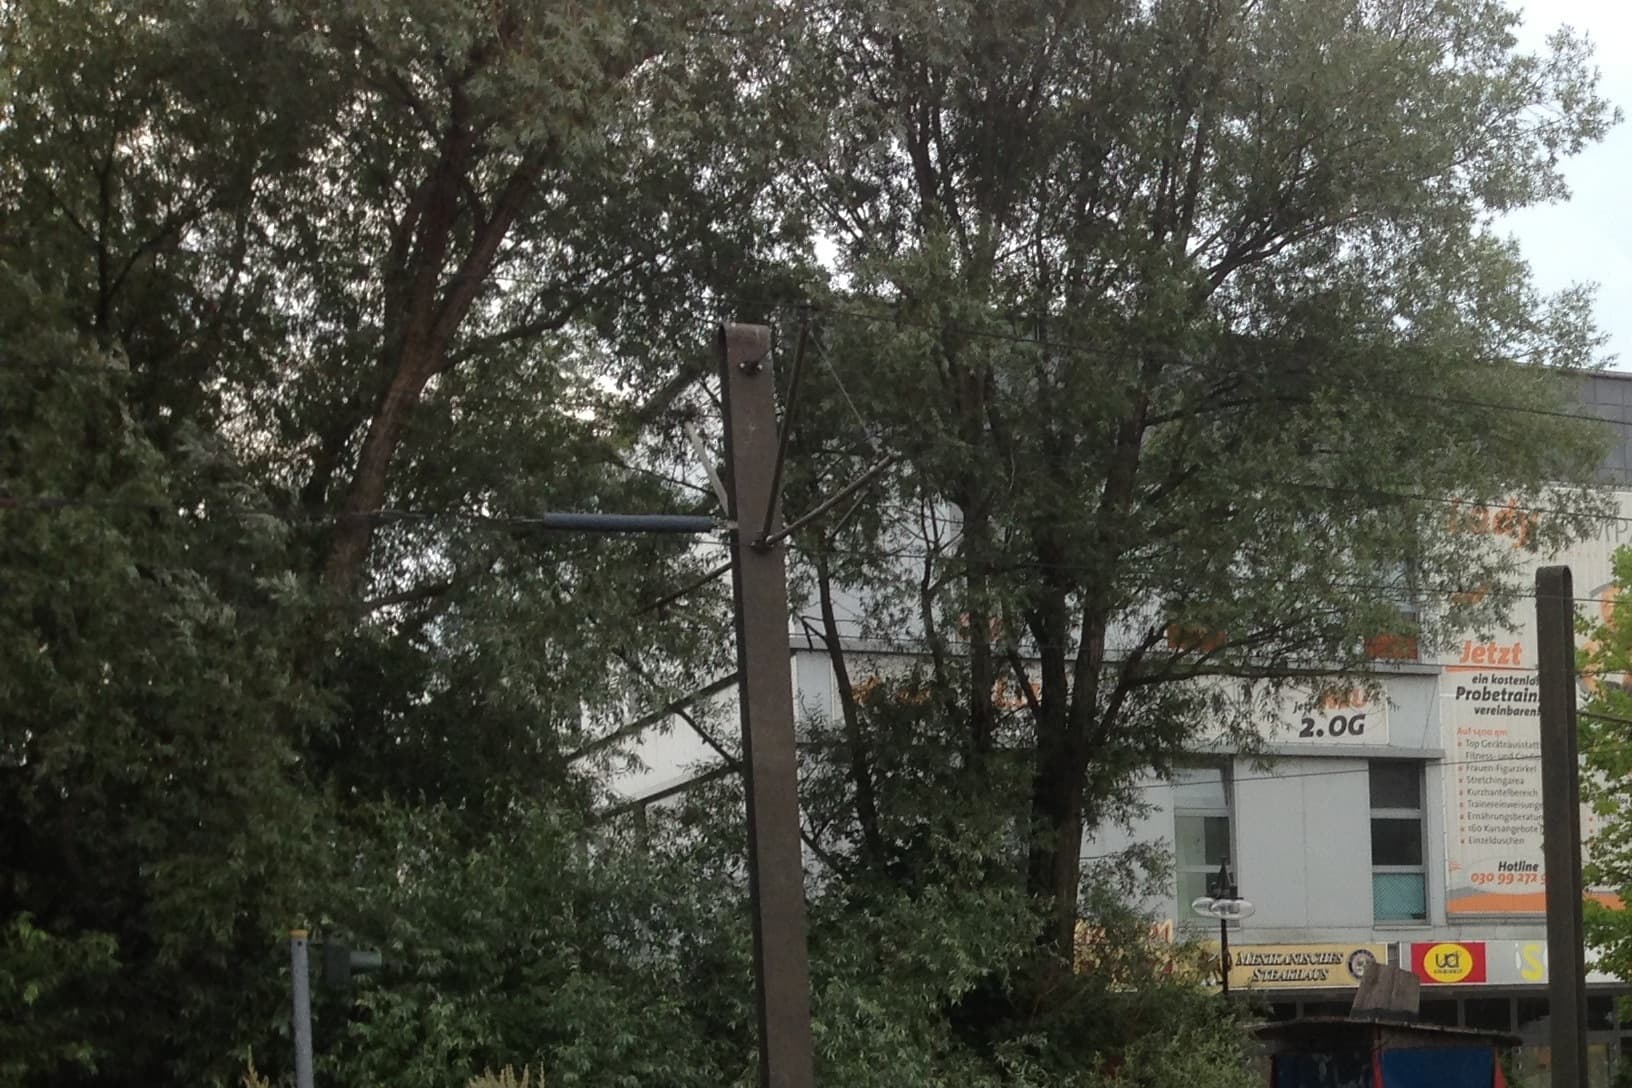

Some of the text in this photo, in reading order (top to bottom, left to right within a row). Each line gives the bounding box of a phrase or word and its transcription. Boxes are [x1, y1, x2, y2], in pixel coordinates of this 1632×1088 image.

[1472, 672, 1540, 686] ein kostenlo
[1455, 685, 1540, 702] Probetrain
[1498, 861, 1539, 872] Hotline
[1471, 872, 1494, 885] 030
